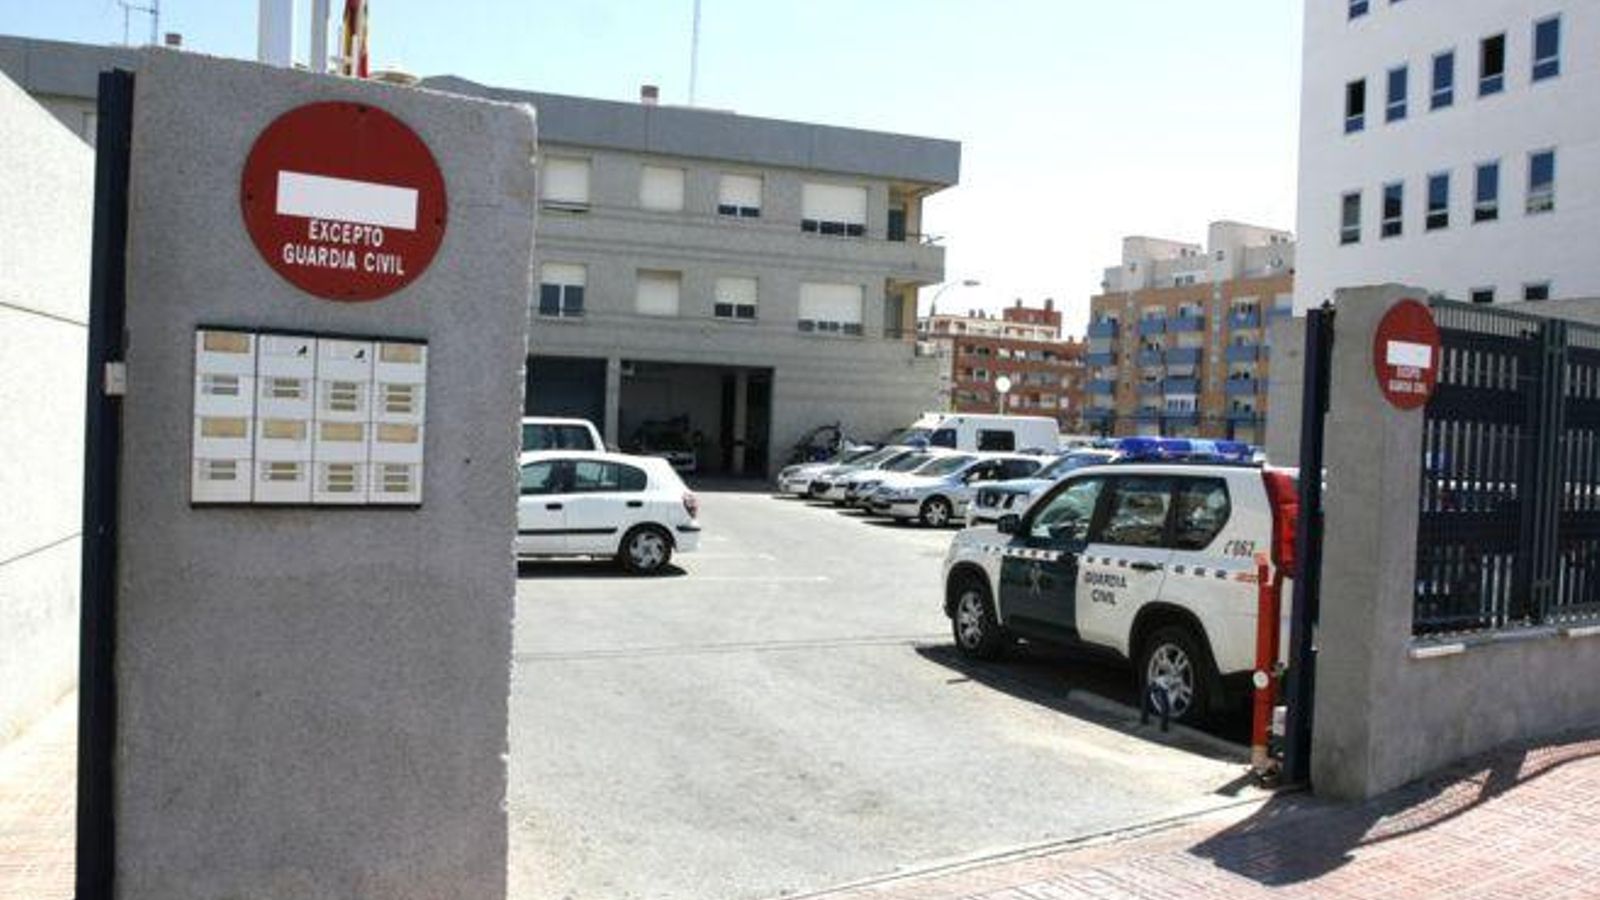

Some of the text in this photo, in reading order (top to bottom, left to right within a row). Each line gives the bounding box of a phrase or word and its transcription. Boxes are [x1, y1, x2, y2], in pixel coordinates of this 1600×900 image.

[309, 219, 384, 247] EXCEPTO
[283, 243, 405, 275] GUARDIA CIVIL
[1084, 571, 1127, 588] GUARDIA
[1091, 589, 1116, 605] CIVIL
